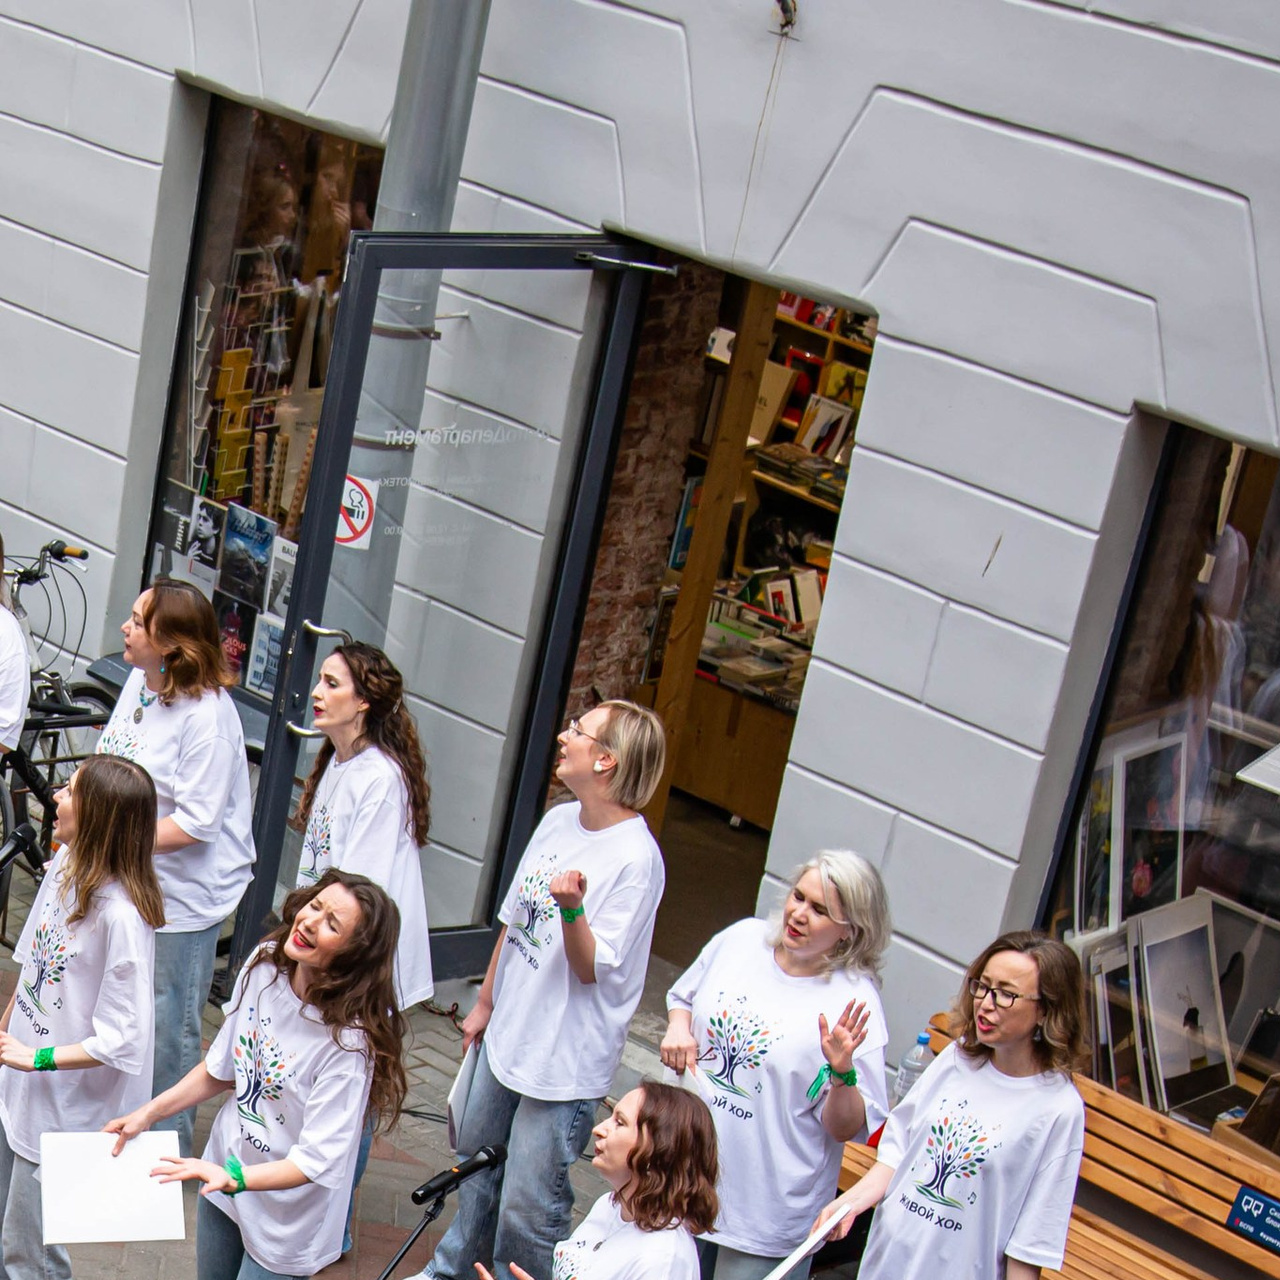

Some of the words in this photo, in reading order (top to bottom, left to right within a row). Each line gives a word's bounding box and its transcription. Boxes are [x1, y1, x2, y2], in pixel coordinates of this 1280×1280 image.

[32, 1018, 50, 1037] ОР
[728, 1103, 754, 1120] ХОР
[245, 1132, 271, 1153] ХОР
[934, 1216, 963, 1232] ХОР
